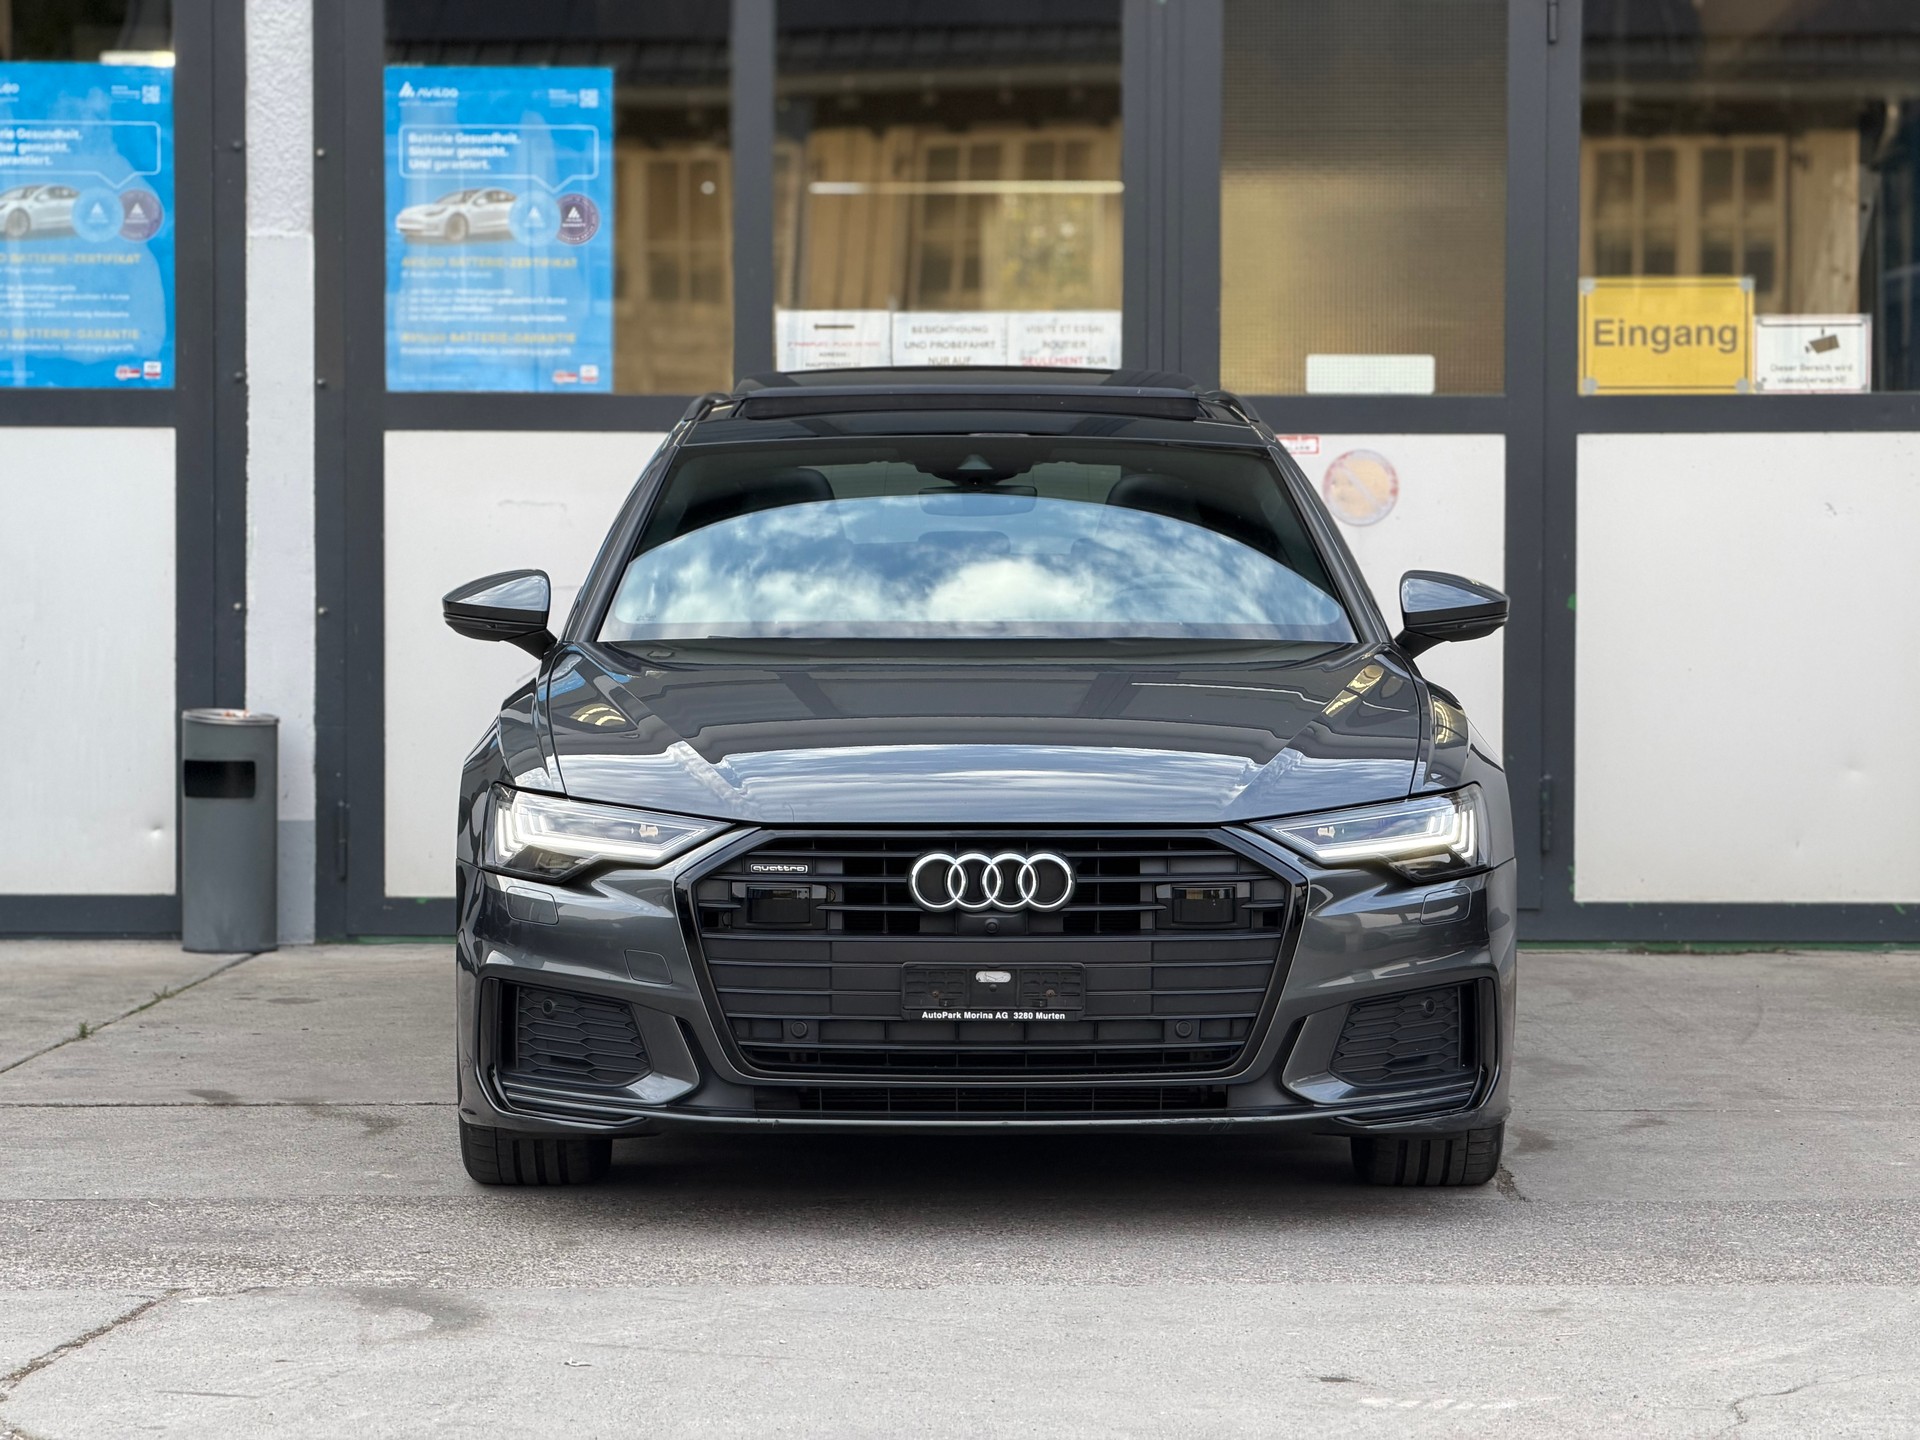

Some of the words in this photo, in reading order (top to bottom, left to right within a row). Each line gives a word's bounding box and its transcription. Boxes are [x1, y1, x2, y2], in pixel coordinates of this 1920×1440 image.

[408, 132, 453, 144] Batterie
[911, 325, 989, 334] BESICHTIGUNG
[1593, 319, 1738, 354] Eingang
[904, 341, 927, 350] UND
[929, 341, 996, 350] PROBEFAHRT
[928, 356, 951, 366] NUR
[1086, 356, 1108, 366] SUR
[752, 864, 805, 872] quattro
[921, 1011, 962, 1019] AutoPark
[963, 1011, 993, 1019] Morina
[995, 1011, 1009, 1019] AG
[1013, 1011, 1033, 1020] 3280
[1035, 1011, 1066, 1020] Murten
